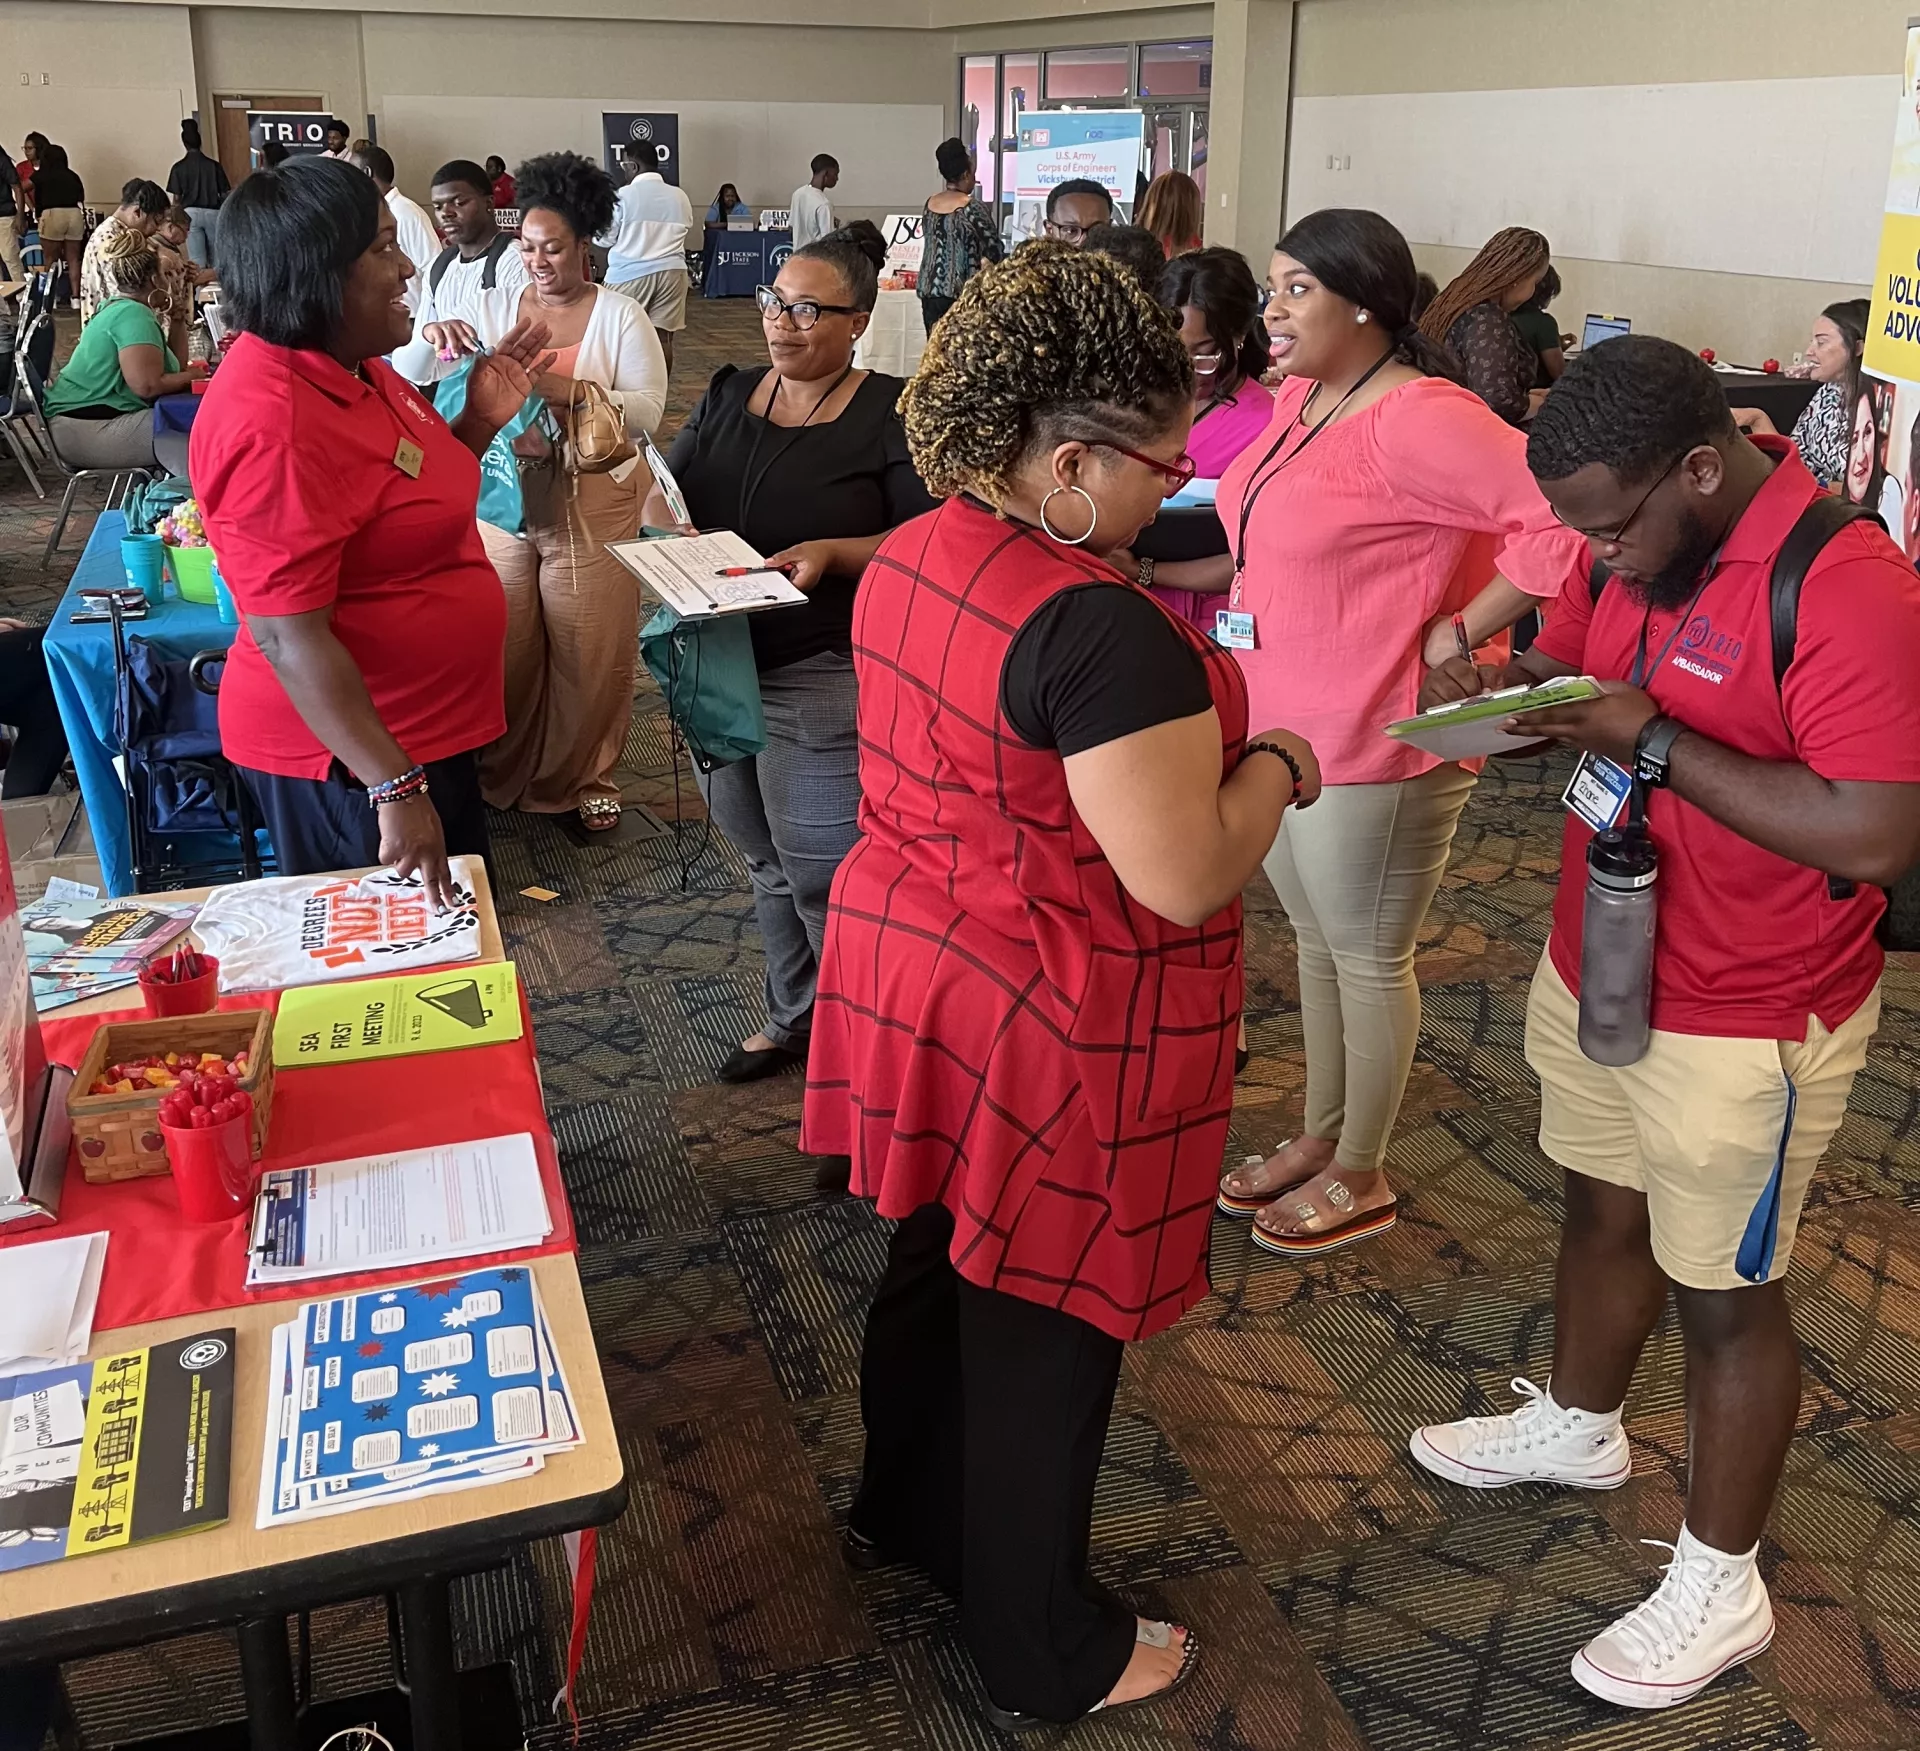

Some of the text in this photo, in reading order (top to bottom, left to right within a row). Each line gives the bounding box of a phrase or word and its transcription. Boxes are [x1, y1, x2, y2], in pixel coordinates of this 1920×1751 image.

[259, 123, 324, 142] TRIO
[610, 144, 671, 162] TO
[1072, 151, 1097, 163] Army
[1036, 163, 1117, 175] Corps of Engineers
[772, 219, 788, 227] WIT
[1884, 309, 1920, 345] ADV
[1671, 655, 1724, 685] AMBASSADOR
[300, 896, 328, 951] DEGREES
[327, 892, 383, 948] NOT
[385, 891, 429, 942] DEBT
[330, 1022, 353, 1050] FIRST
[362, 1001, 386, 1047] MEETING
[298, 1031, 321, 1053] SEA
[328, 1359, 338, 1387] OVERVIEW
[14, 1413, 30, 1433] OUR
[32, 1390, 53, 1447] COMMUNITIES
[304, 1434, 314, 1476] WANT TO JOIN
